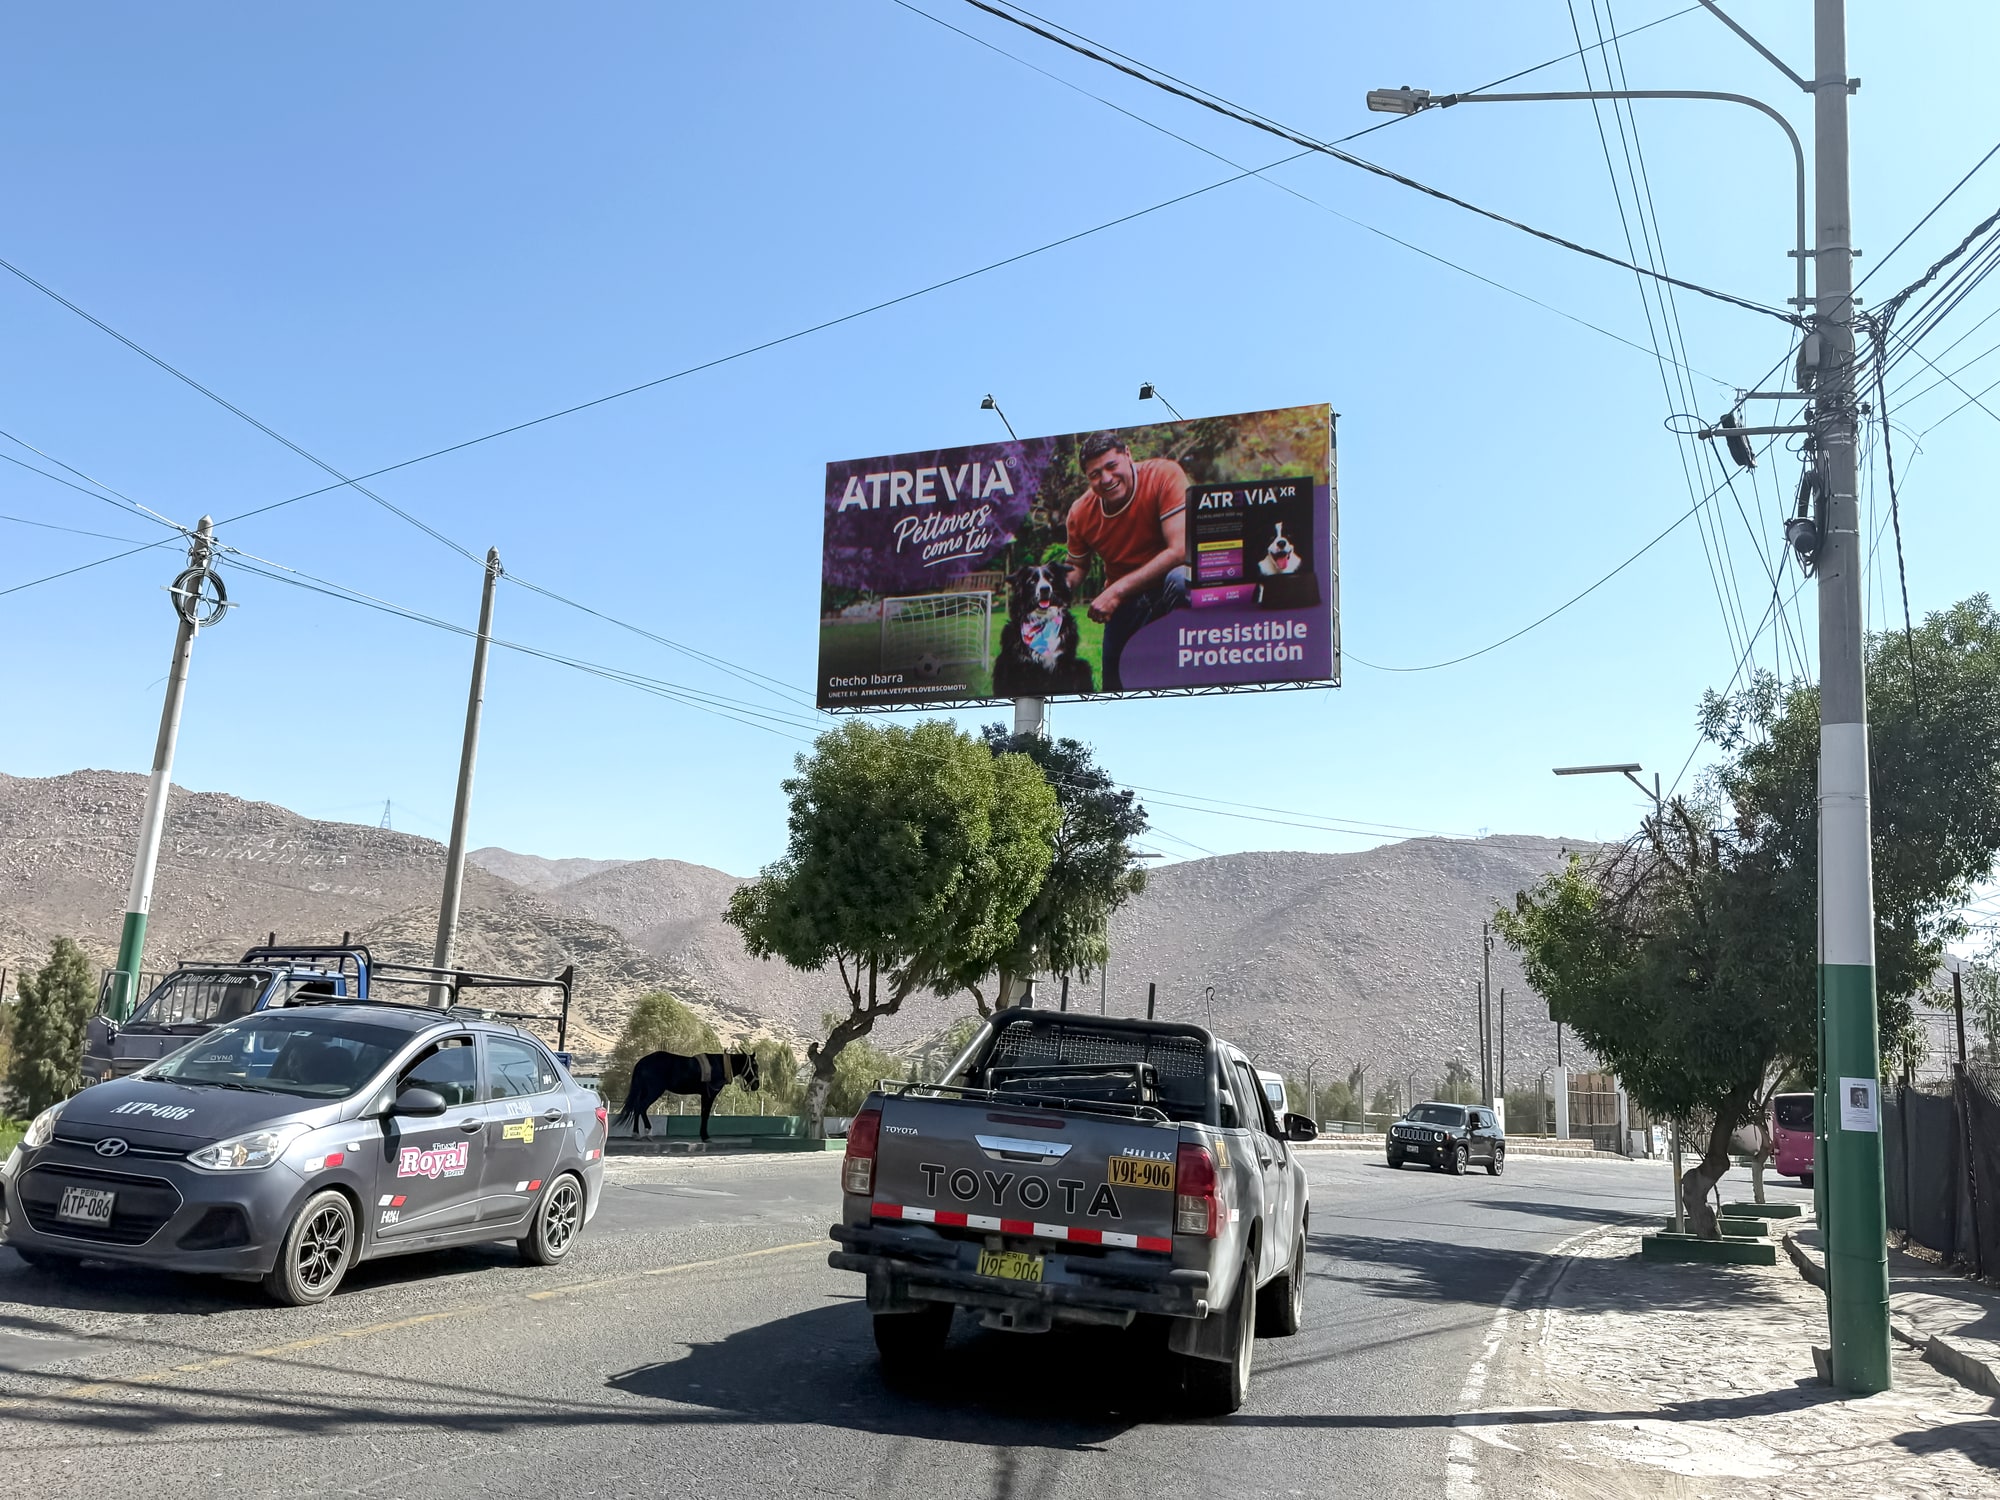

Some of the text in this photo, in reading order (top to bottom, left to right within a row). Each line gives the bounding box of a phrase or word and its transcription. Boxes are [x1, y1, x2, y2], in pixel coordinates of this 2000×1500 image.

[1279, 486, 1296, 497] XR
[893, 504, 992, 553] Petlovers
[922, 527, 992, 560] como tú
[1178, 620, 1307, 646] Irresistible
[1178, 642, 1303, 667] Protección
[829, 674, 903, 687] Checho Ibarra
[860, 684, 967, 696] ATREVIA.VET/PETLOVERSCOMOTU
[218, 974, 247, 984] Amor
[109, 1101, 195, 1120] ATP-086
[885, 1125, 918, 1135] TOYOTA
[399, 1145, 467, 1177] Royal
[1122, 1147, 1173, 1160] HILUX
[1112, 1160, 1171, 1187] V9E-906
[80, 1189, 99, 1197] PERU
[919, 1163, 1122, 1219] TOYOTA
[61, 1194, 111, 1218] ATP-086
[1001, 1251, 1024, 1260] PERU
